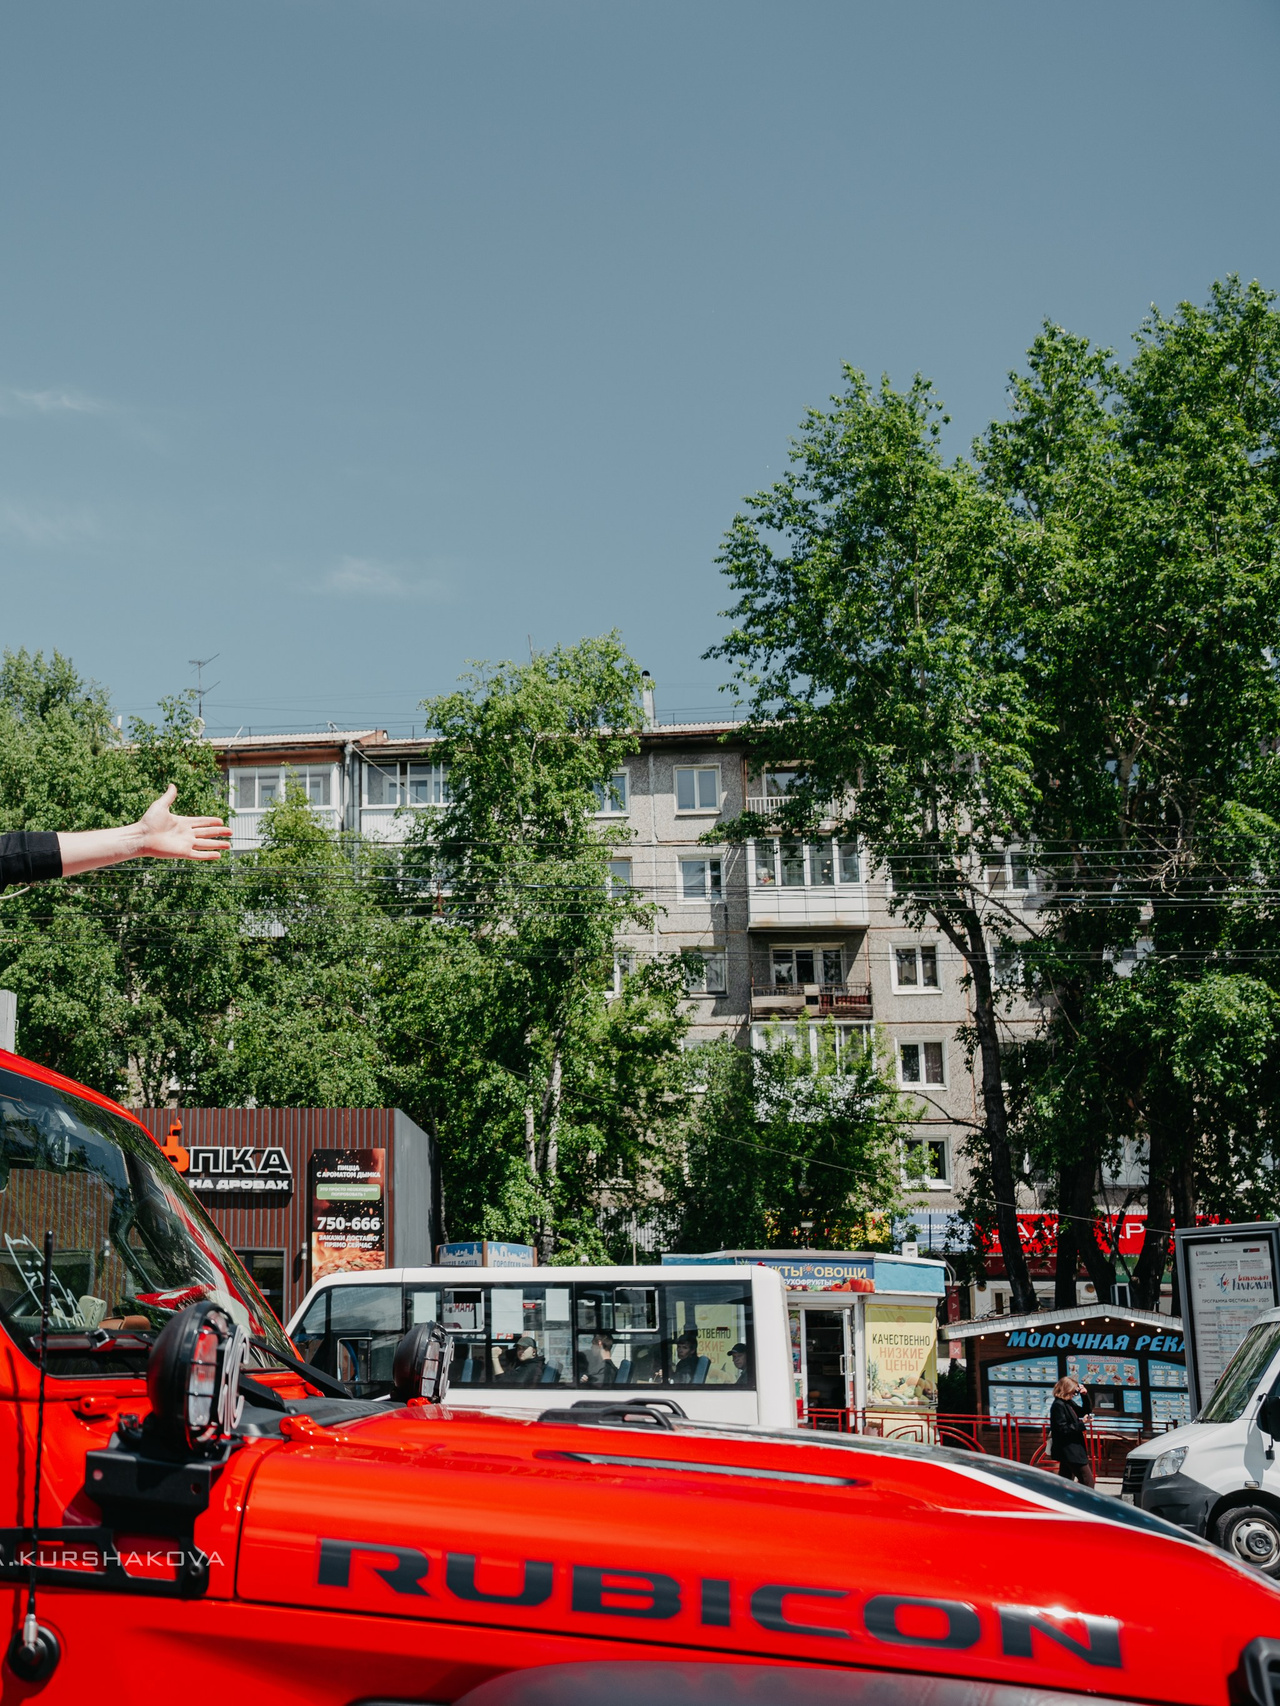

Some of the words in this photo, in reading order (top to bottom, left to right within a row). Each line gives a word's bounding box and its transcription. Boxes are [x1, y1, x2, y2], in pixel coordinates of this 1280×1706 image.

[160, 1134, 293, 1173] ОПКА
[189, 1179, 214, 1189] НА
[216, 1180, 289, 1190] ДРОВАХ
[317, 1217, 381, 1231] 750-666
[348, 1241, 373, 1249] СЕЙЧАС
[772, 1266, 803, 1276] КТЫ
[814, 1267, 867, 1279] ОВОЩИ
[697, 1328, 731, 1339] СТВЕННО
[872, 1333, 930, 1346] КАЧЕСТВЕННО
[698, 1340, 725, 1352] ЗКИЕ
[1007, 1331, 1130, 1350] МОЛОЧНАЯ
[879, 1346, 924, 1360] НИЗКИЕ
[885, 1359, 919, 1373] ЦЕНЫ
[317, 1538, 1123, 1669] RUBICON
